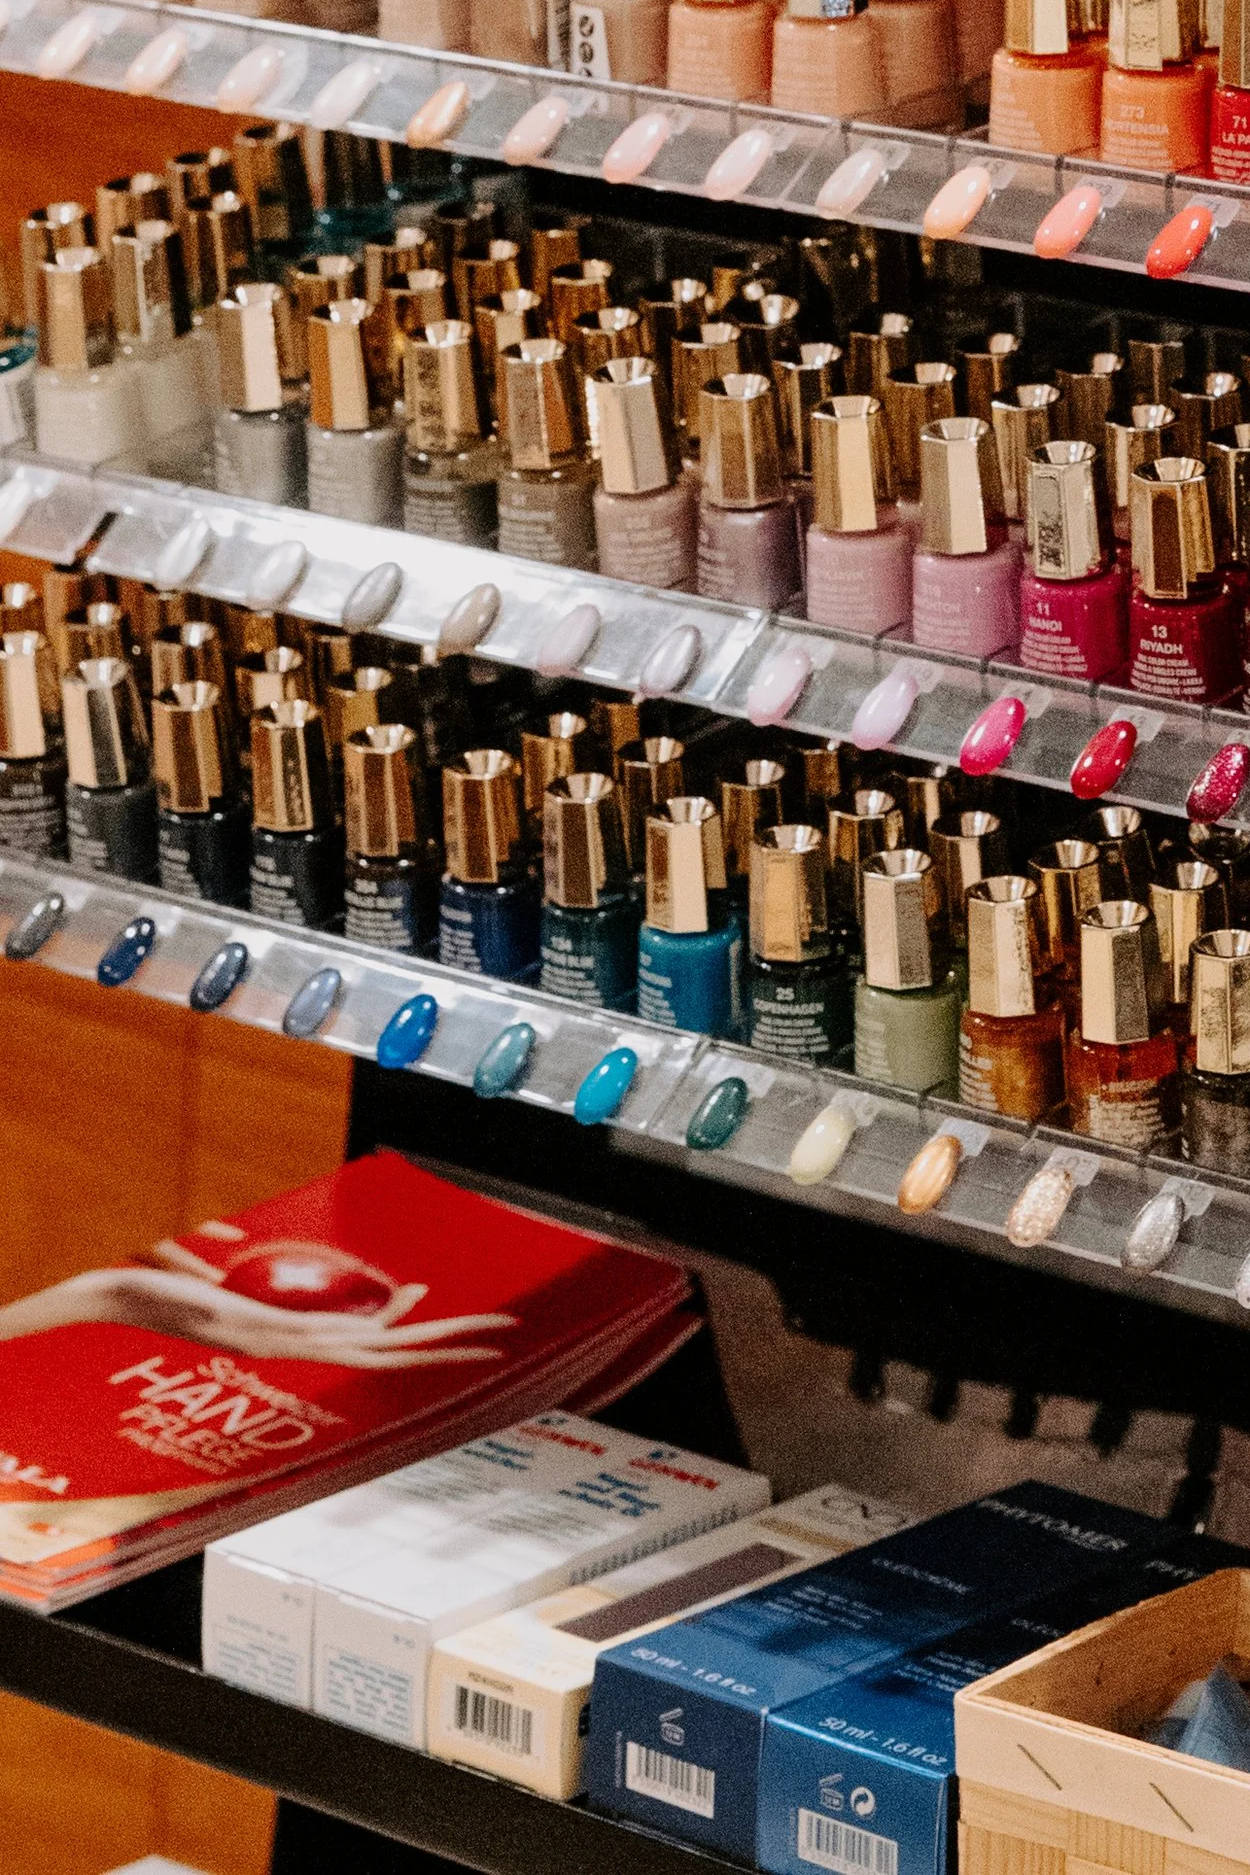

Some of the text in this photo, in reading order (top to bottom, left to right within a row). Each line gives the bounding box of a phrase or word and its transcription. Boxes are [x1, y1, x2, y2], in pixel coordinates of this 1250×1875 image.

[1232, 115, 1247, 129] 71
[1222, 132, 1235, 144] LA
[1036, 602, 1050, 616] 11
[1151, 624, 1168, 639] 13
[1139, 638, 1183, 655] RIYADH
[776, 987, 795, 1001] 25
[108, 1354, 314, 1451] HAND
[630, 1646, 658, 1663] 50
[657, 1652, 679, 1670] ml
[691, 1667, 722, 1685] 1.6
[732, 1680, 757, 1696] oz
[818, 1716, 846, 1732] 50
[845, 1722, 870, 1739] ml
[880, 1736, 910, 1753] 1.6
[922, 1750, 949, 1766] oz
